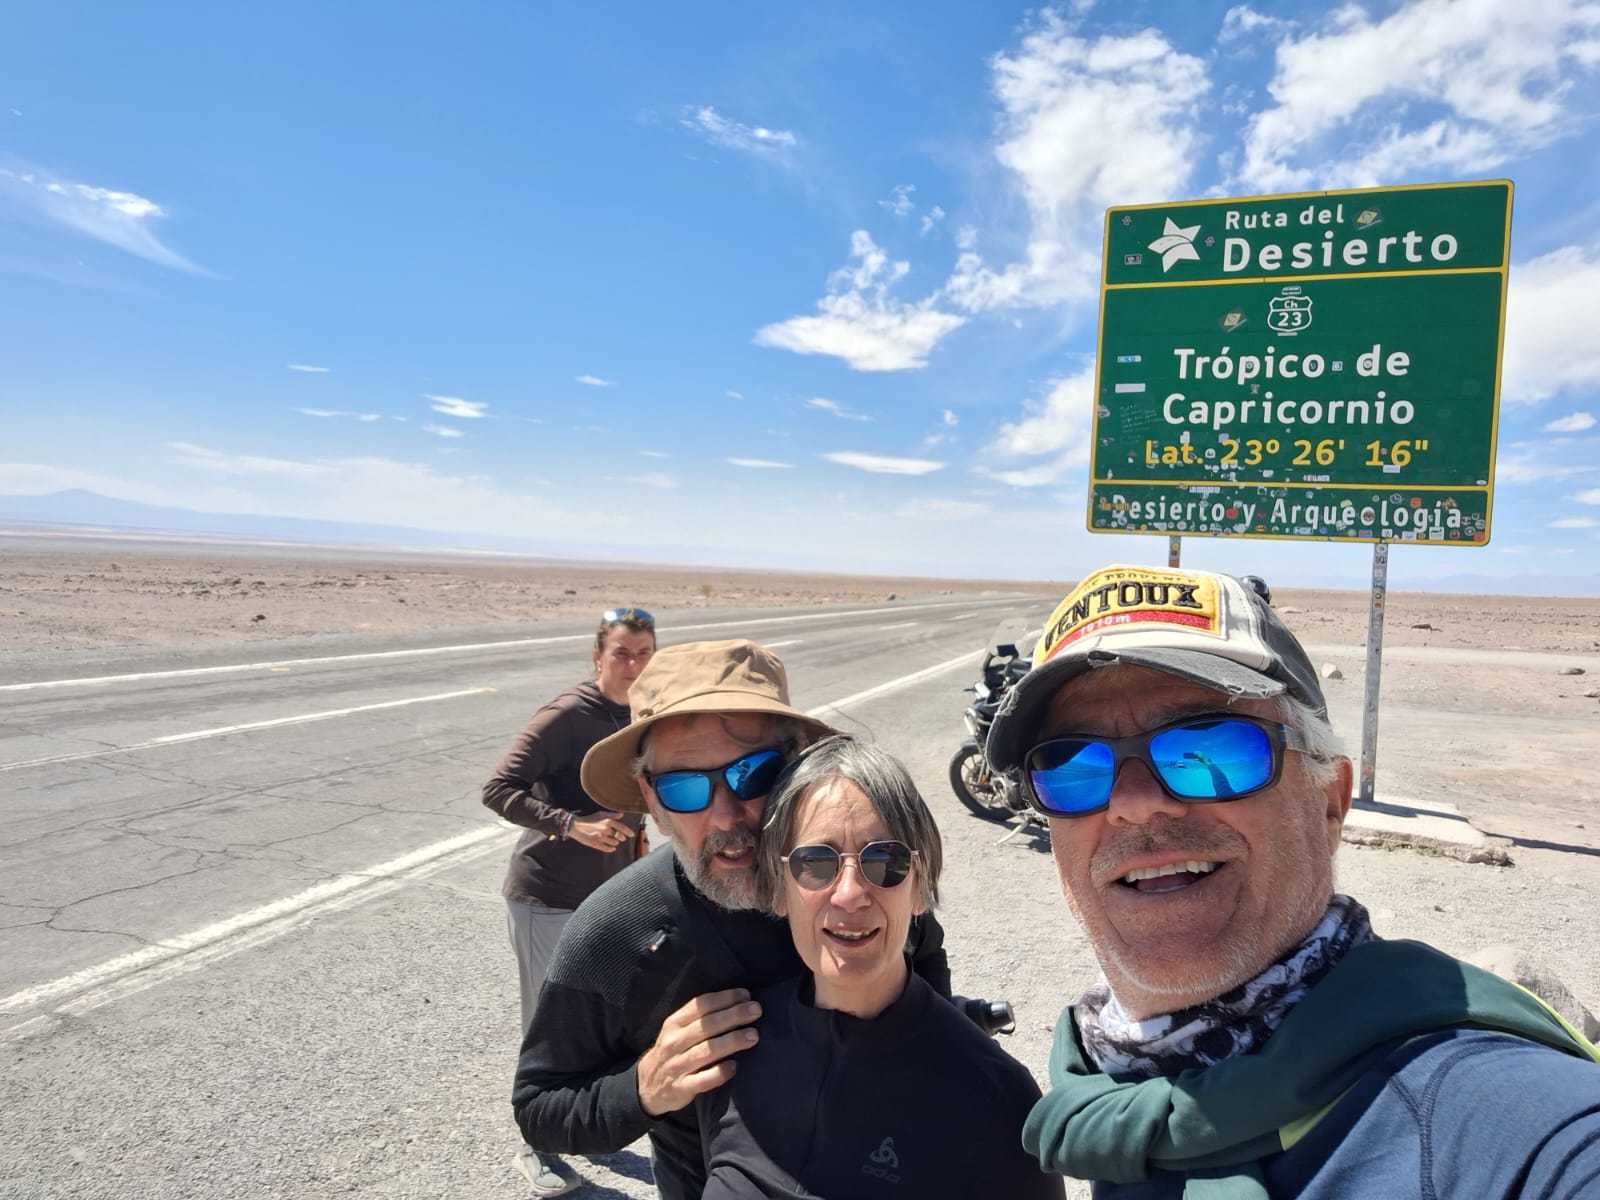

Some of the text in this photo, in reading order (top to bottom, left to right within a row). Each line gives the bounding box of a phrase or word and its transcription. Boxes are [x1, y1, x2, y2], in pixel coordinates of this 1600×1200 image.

[1225, 203, 1345, 230] Ruta del
[1223, 230, 1458, 272] Desierto
[1278, 312, 1302, 326] 23
[1284, 300, 1298, 309] Ch
[1174, 344, 1410, 385] Trópico de
[1163, 391, 1415, 430] Capricornio
[1145, 439, 1204, 465] Lat.
[1292, 439, 1345, 466] 26'
[1365, 439, 1429, 467] 16"
[1112, 494, 1225, 521] Desierto
[1242, 503, 1256, 527] y
[1045, 581, 1203, 651] VENTOUX
